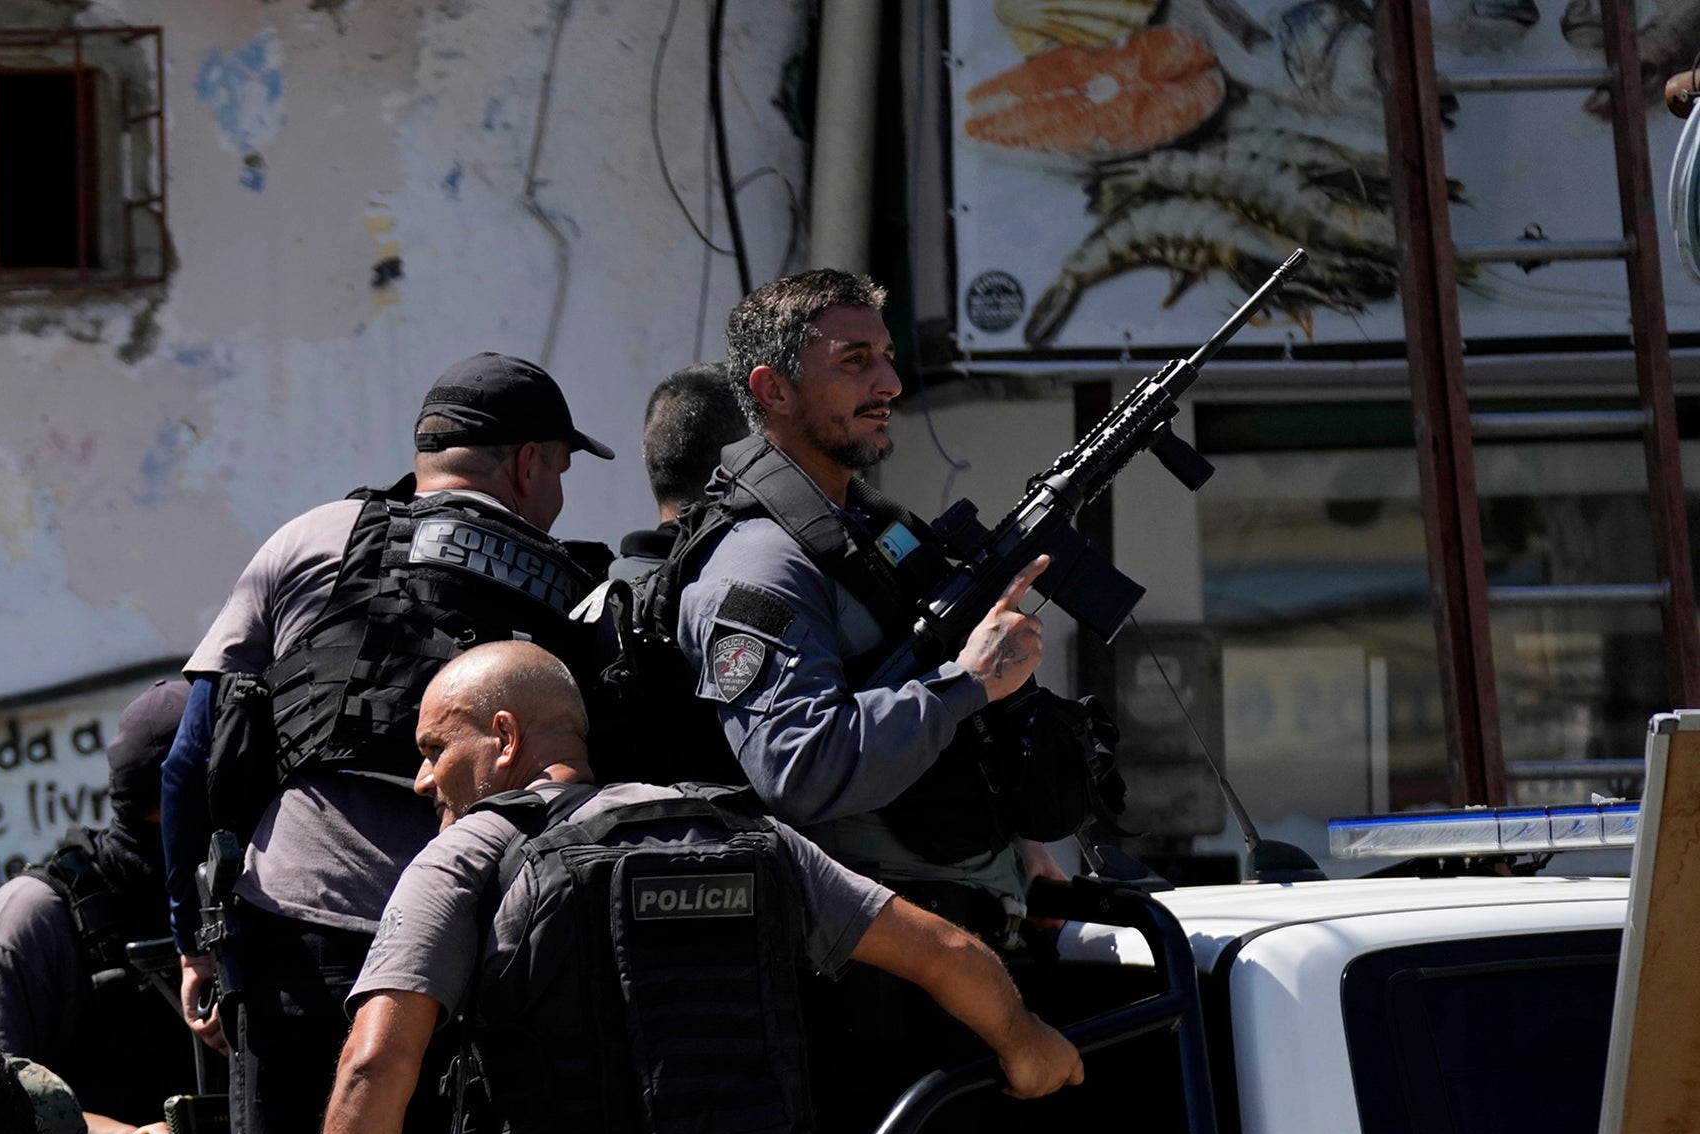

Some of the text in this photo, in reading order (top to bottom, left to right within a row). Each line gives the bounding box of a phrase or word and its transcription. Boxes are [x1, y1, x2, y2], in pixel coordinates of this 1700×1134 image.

[745, 640, 761, 654] CIVIL
[71, 719, 103, 755] a
[638, 882, 749, 913] POLÍCIA
